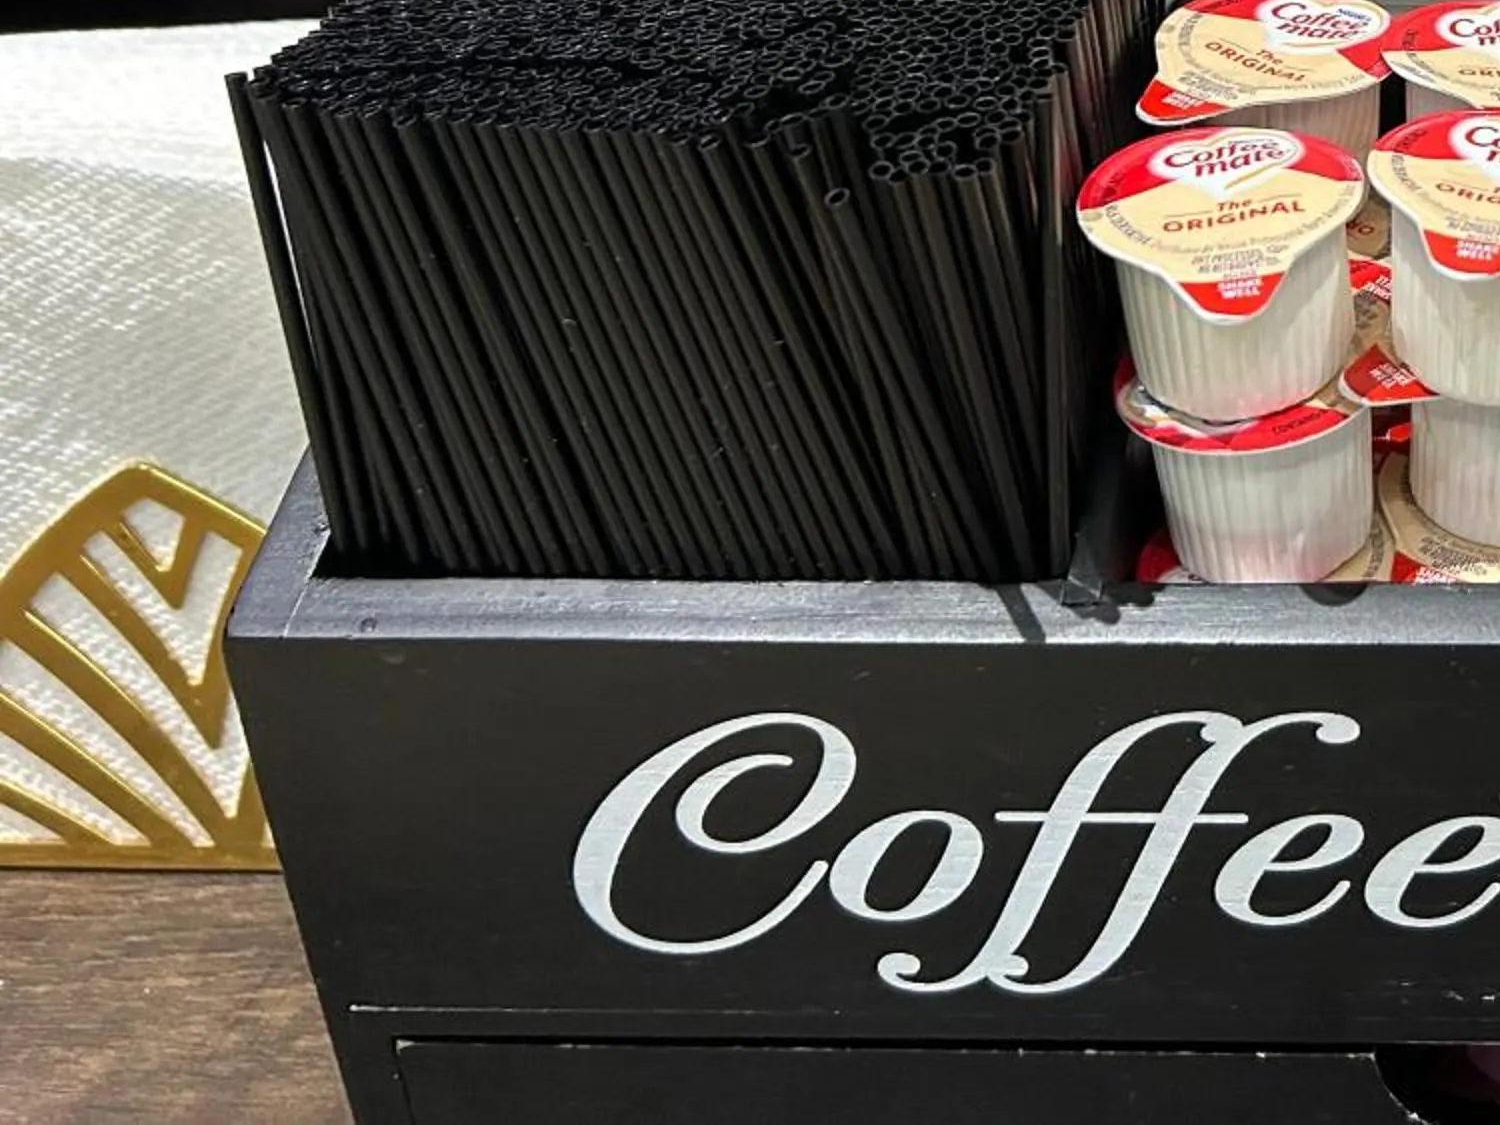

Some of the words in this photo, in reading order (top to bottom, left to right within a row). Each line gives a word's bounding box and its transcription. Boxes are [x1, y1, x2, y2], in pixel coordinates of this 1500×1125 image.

[1272, 2, 1369, 32] Coffee
[1277, 22, 1362, 40] mate
[1205, 41, 1306, 82] ORIGINAL
[1257, 49, 1282, 65] The
[1164, 139, 1279, 168] Coffee
[1194, 148, 1286, 177] mate
[1163, 200, 1306, 232] ORIGINAL
[1216, 198, 1253, 212] The
